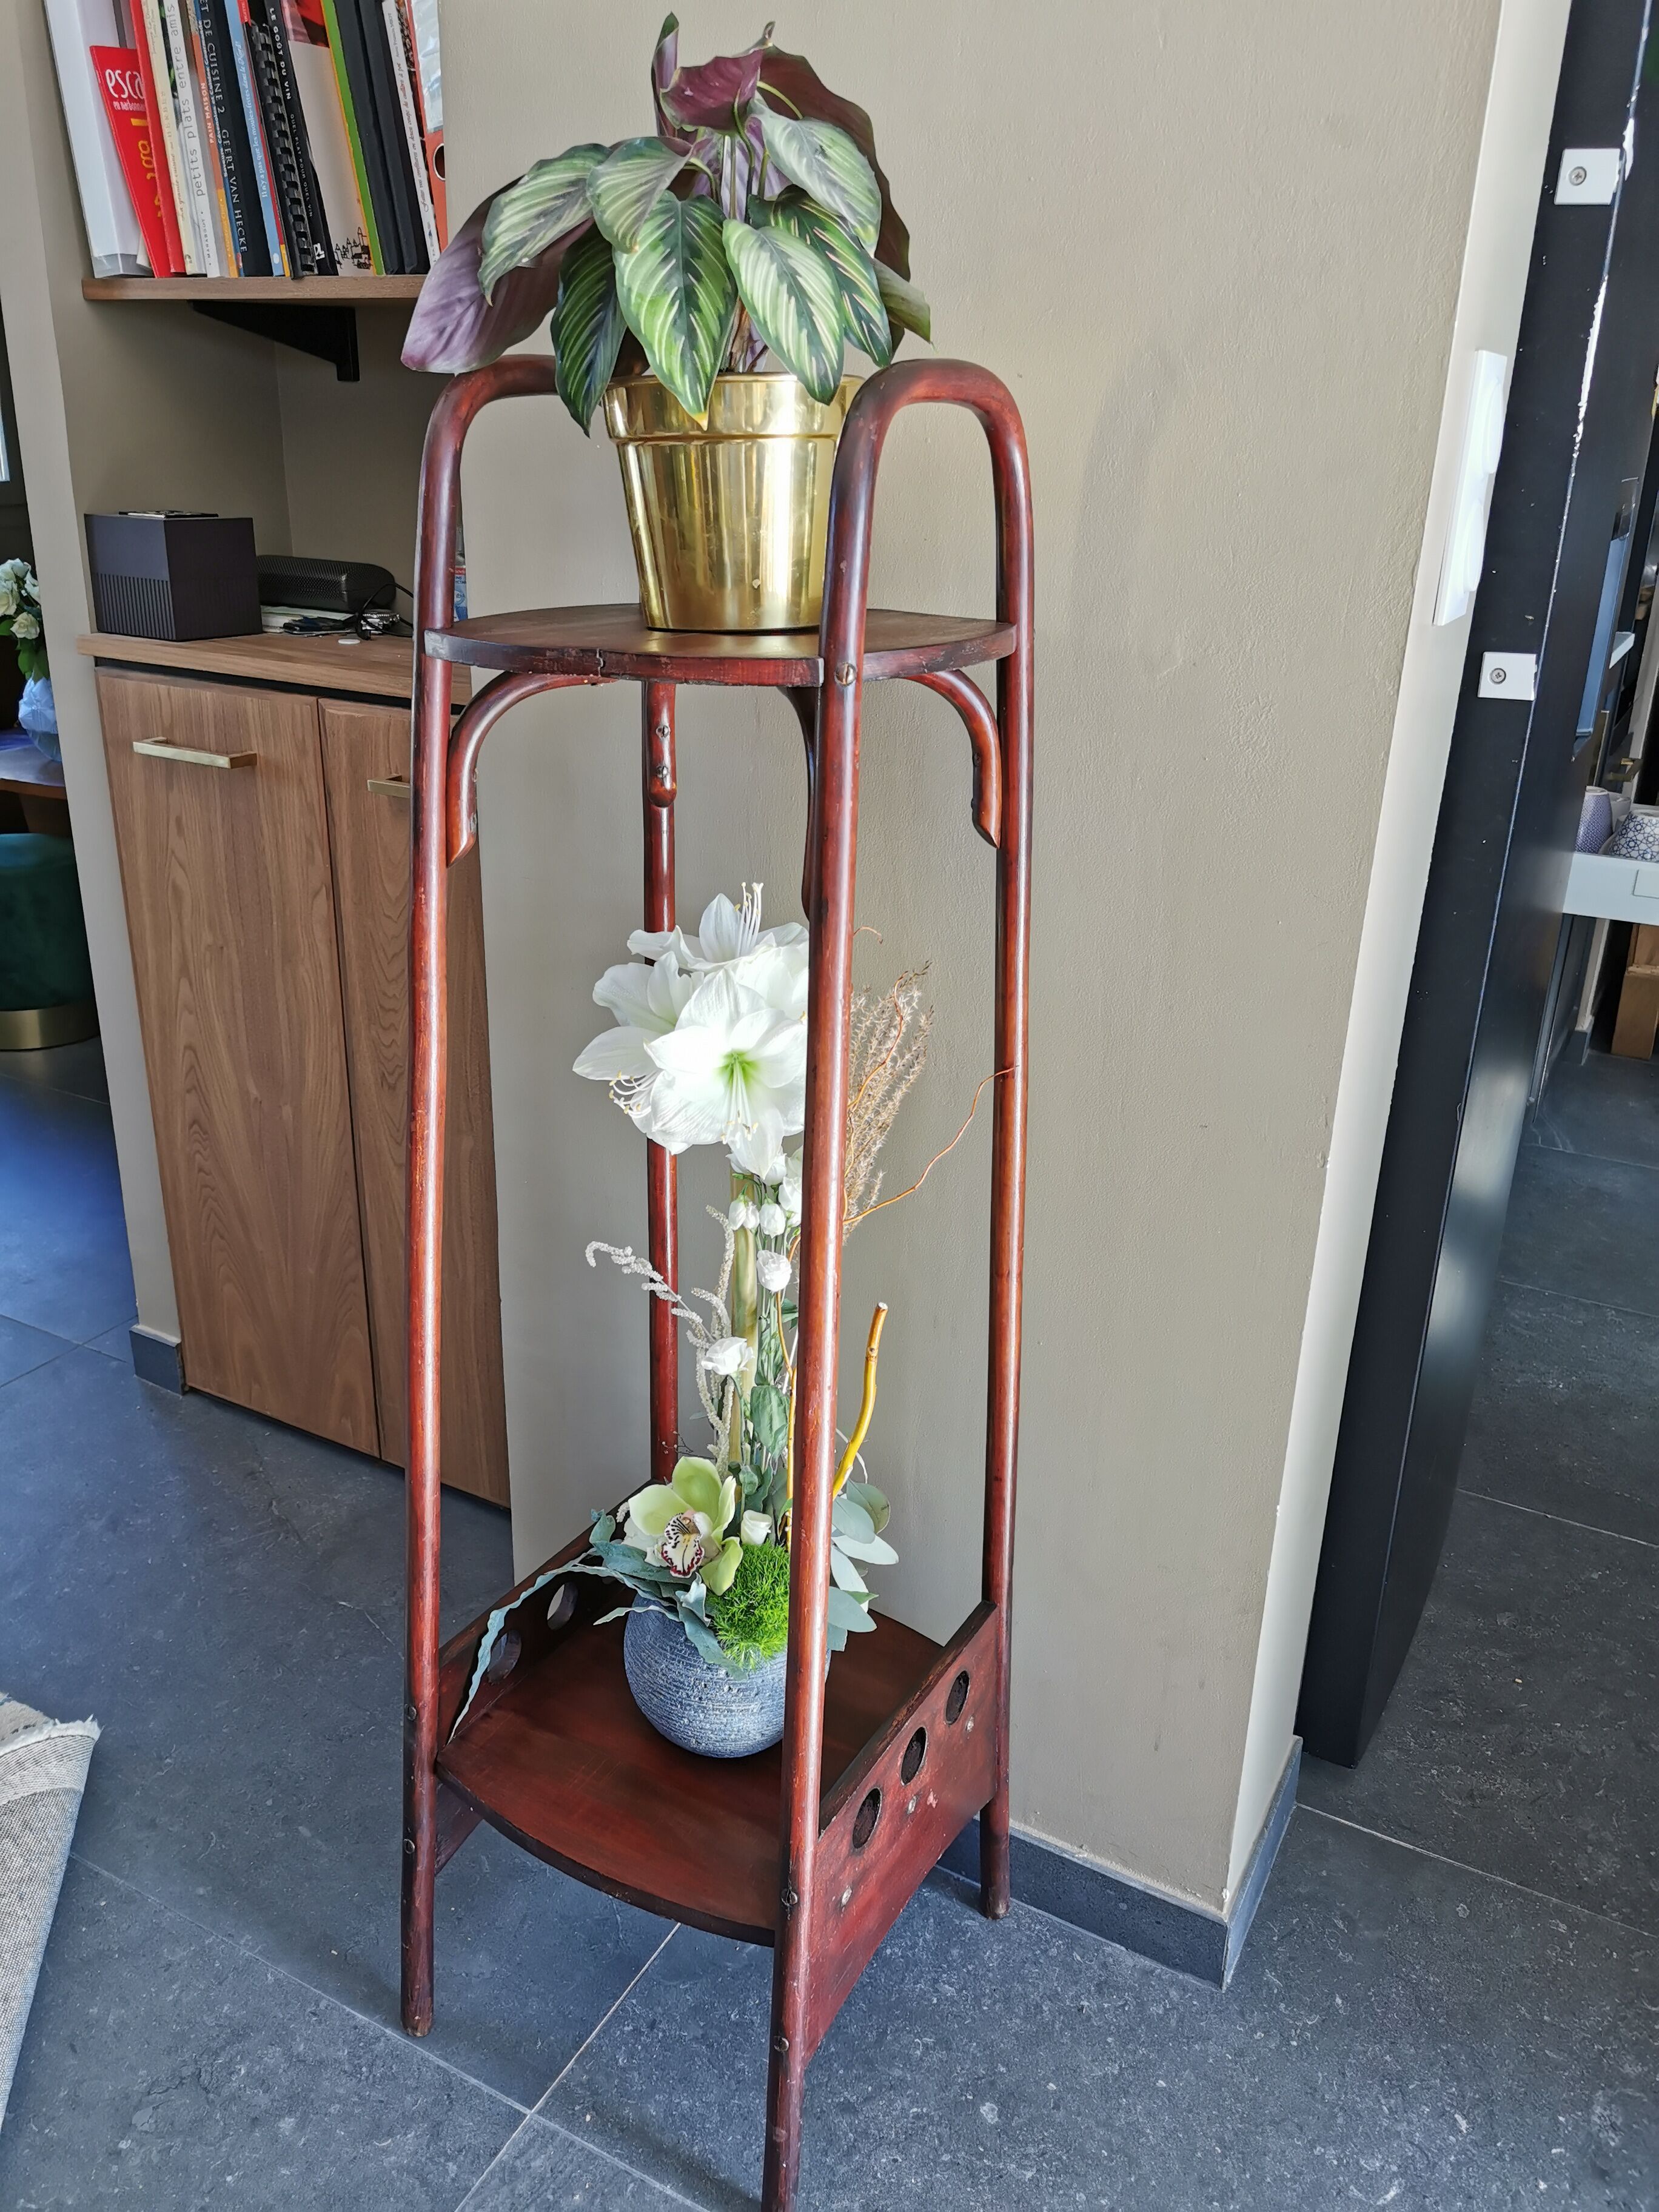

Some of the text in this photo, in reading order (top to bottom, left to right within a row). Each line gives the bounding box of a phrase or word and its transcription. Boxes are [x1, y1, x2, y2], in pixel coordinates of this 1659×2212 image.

[203, 19, 213, 36] DE
[270, 8, 276, 21] LE
[280, 61, 287, 76] DU
[207, 42, 223, 101] CUISINE
[167, 4, 206, 196] petits plats entre amis
[201, 82, 211, 119] MAISON
[222, 130, 235, 171] GEERT
[255, 147, 264, 161] que
[230, 176, 240, 203] VAN
[202, 219, 210, 258] MARABOUT
[235, 210, 247, 252] HECKE
